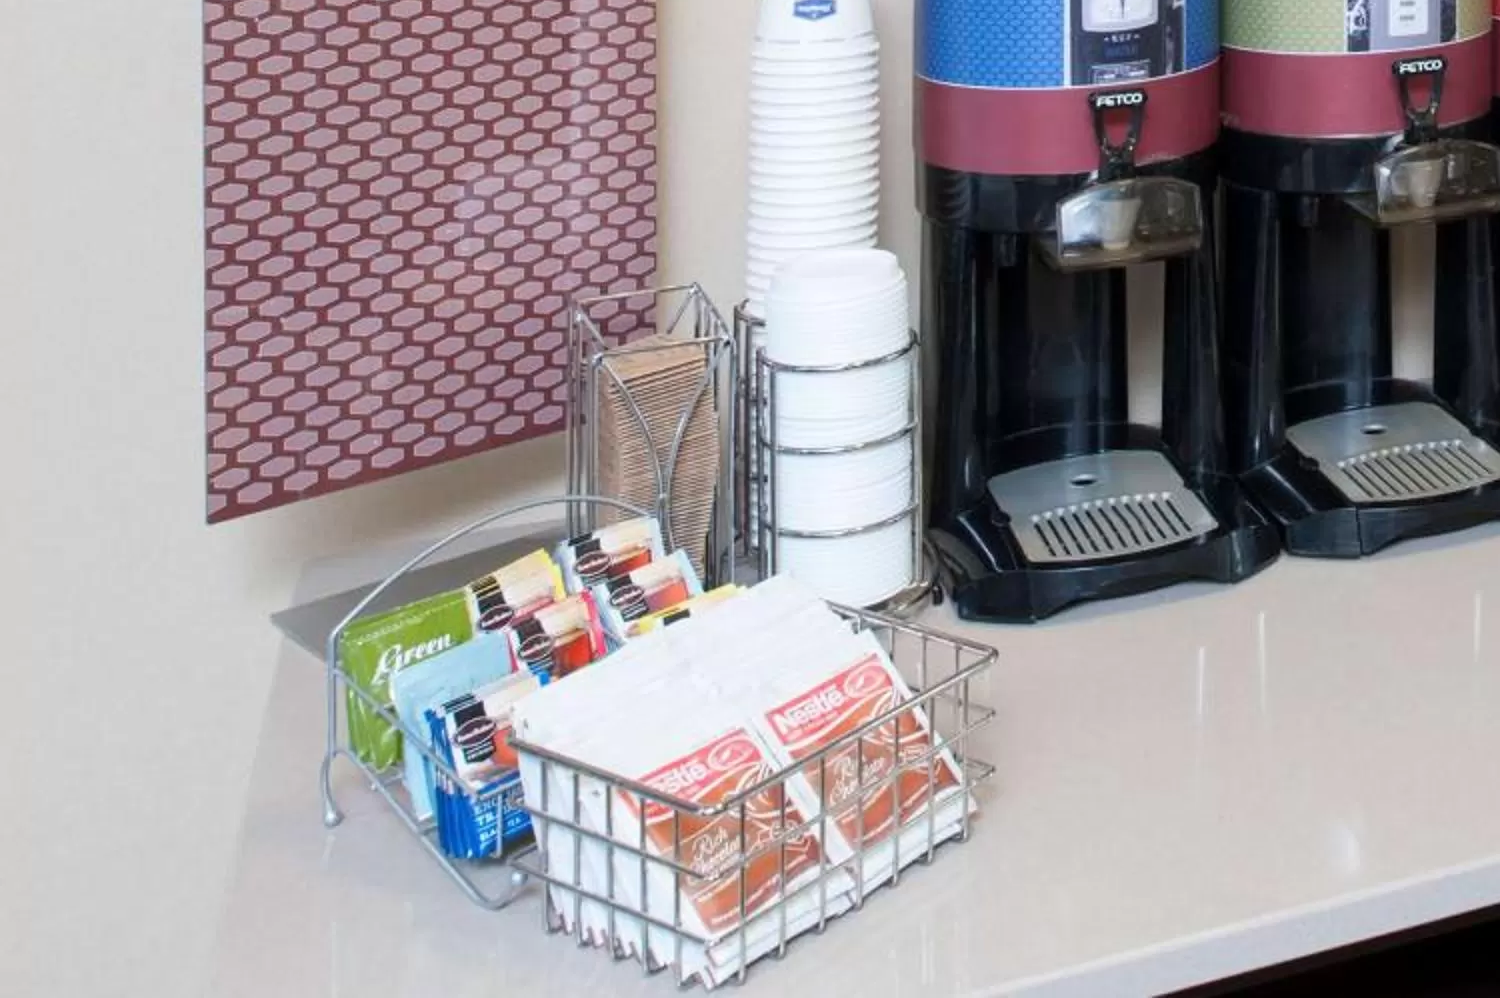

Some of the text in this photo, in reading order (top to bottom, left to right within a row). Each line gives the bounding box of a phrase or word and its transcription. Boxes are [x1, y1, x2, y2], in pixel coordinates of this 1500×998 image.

[1399, 58, 1444, 74] FETCO
[1096, 92, 1144, 108] FETCO
[371, 632, 452, 686] Green
